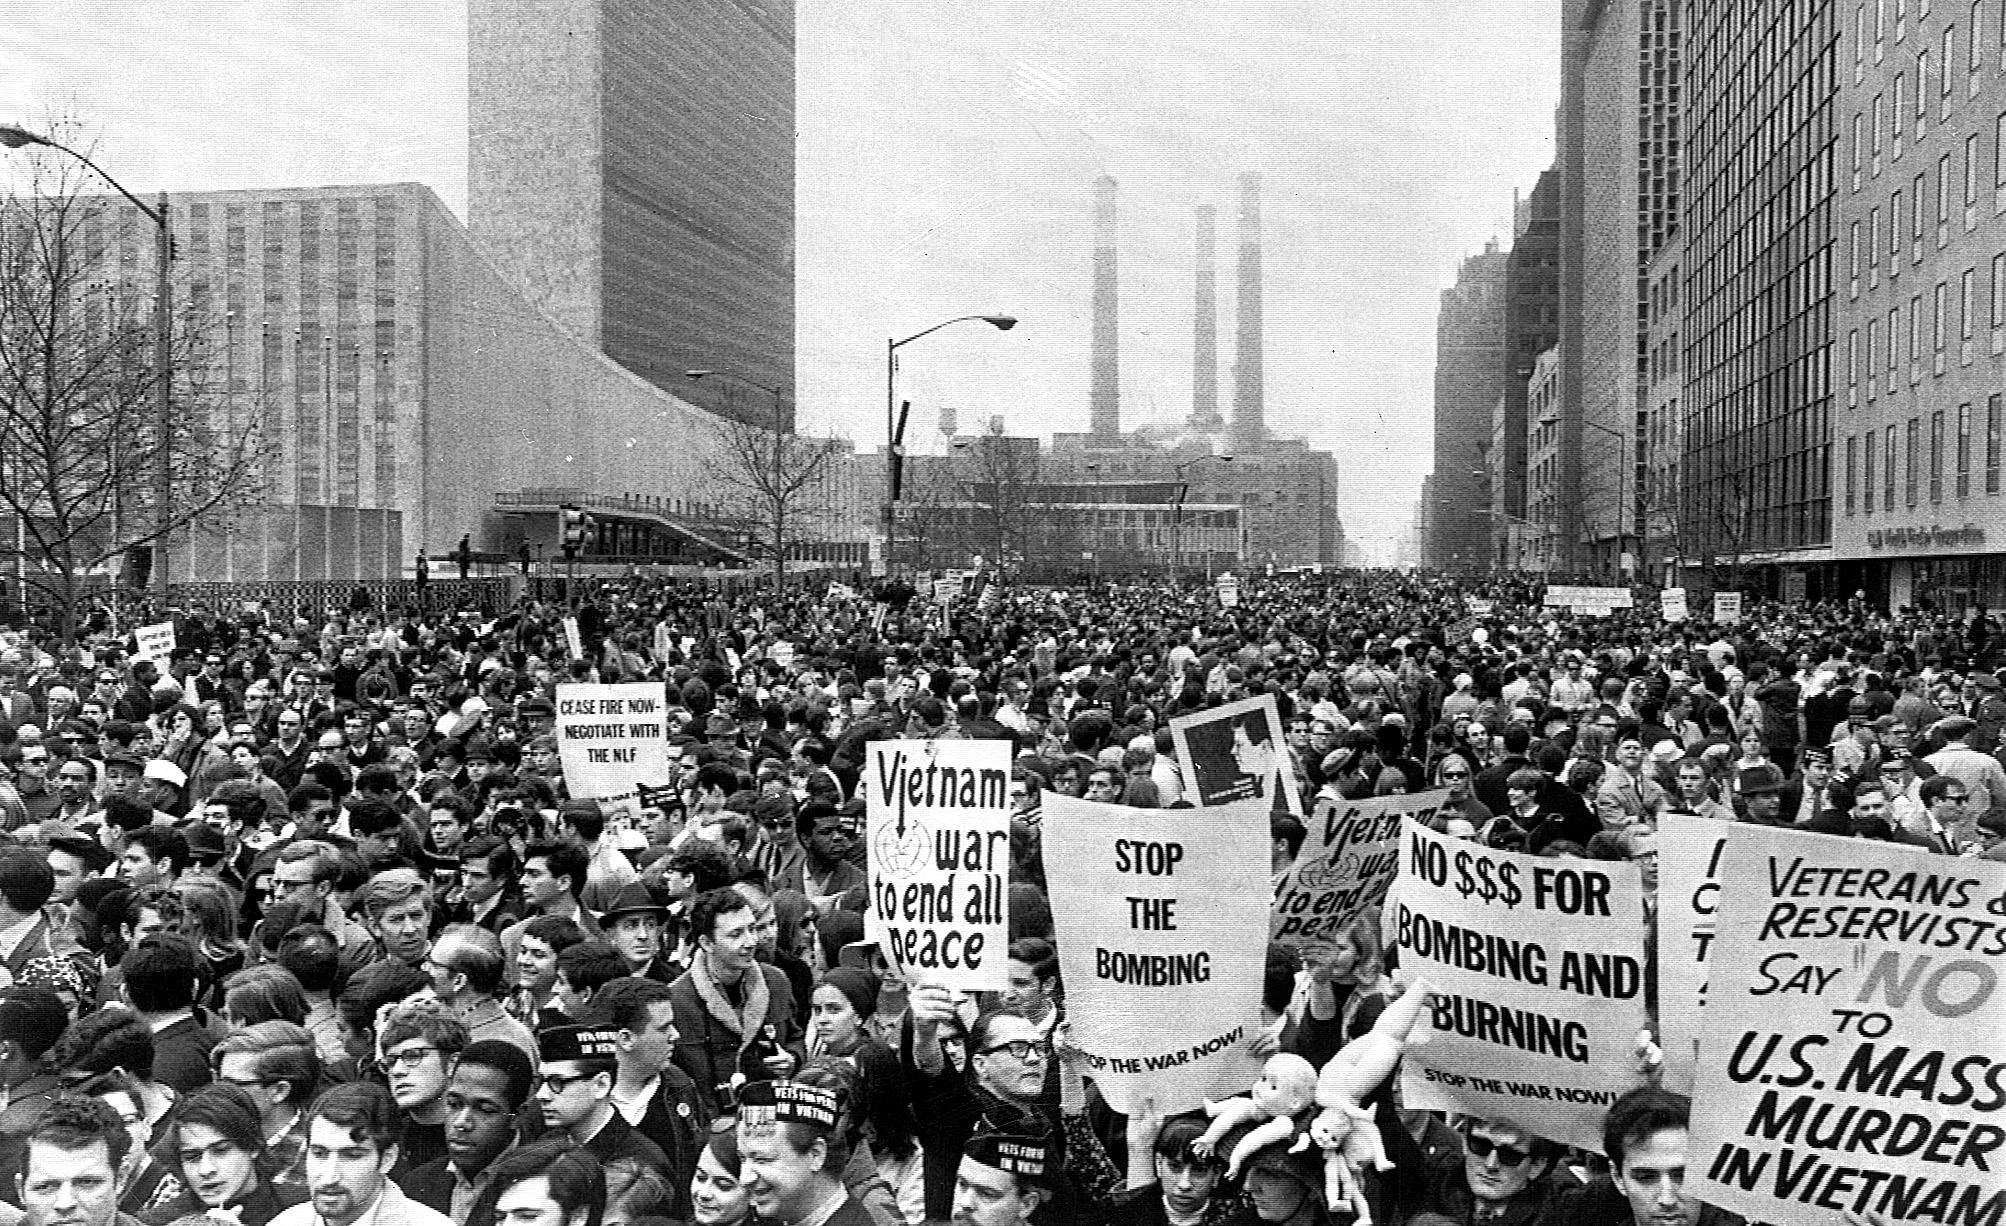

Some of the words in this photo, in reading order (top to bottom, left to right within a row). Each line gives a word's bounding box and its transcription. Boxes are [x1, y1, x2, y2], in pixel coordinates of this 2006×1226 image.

[560, 699, 596, 716] CEASE
[599, 699, 624, 715] FIRE
[627, 697, 662, 714] NOW-
[564, 723, 625, 740] NEGOTIATE
[628, 723, 660, 738] WITH
[586, 747, 610, 763] THE
[612, 746, 638, 763] NLF
[877, 750, 1007, 811] Vietnam
[935, 829, 1008, 872] war
[1114, 838, 1184, 877] STOP
[1357, 847, 1400, 880] wa
[1411, 831, 1448, 888] NO
[1454, 849, 1523, 910] $$$
[1532, 866, 1612, 917] FOR
[1768, 855, 1981, 909] VETERANS
[874, 871, 898, 921] to
[902, 873, 957, 923] end
[963, 873, 1003, 926] all
[1125, 896, 1178, 931] THE
[1278, 885, 1312, 914] to
[1312, 878, 1370, 915] end
[1398, 902, 1549, 987] BOMBING
[1559, 950, 1641, 999] AND
[1757, 902, 2006, 956] RESERVISTS
[888, 927, 985, 976] peace
[1095, 947, 1212, 987] BOMBING
[1749, 951, 1843, 996] SAY
[1431, 994, 1590, 1065] BURNING
[1831, 1008, 1894, 1040] TO
[1083, 1051, 1107, 1071] OP
[1109, 1057, 1142, 1074] THE
[1143, 1050, 1190, 1071] WAR
[1192, 1025, 1244, 1060] NOW!
[1726, 1030, 1830, 1090] U.S.
[1834, 1042, 2006, 1113] MASS
[774, 1087, 798, 1100] VETS
[1424, 1067, 1467, 1088] STOP
[1468, 1076, 1505, 1095] THE
[1504, 1080, 1555, 1101] WAR
[777, 1102, 791, 1115] IN
[1744, 1089, 2006, 1172] MURDER
[1706, 1142, 1772, 1192] IN
[1772, 1147, 2006, 1226] VIETNAM
